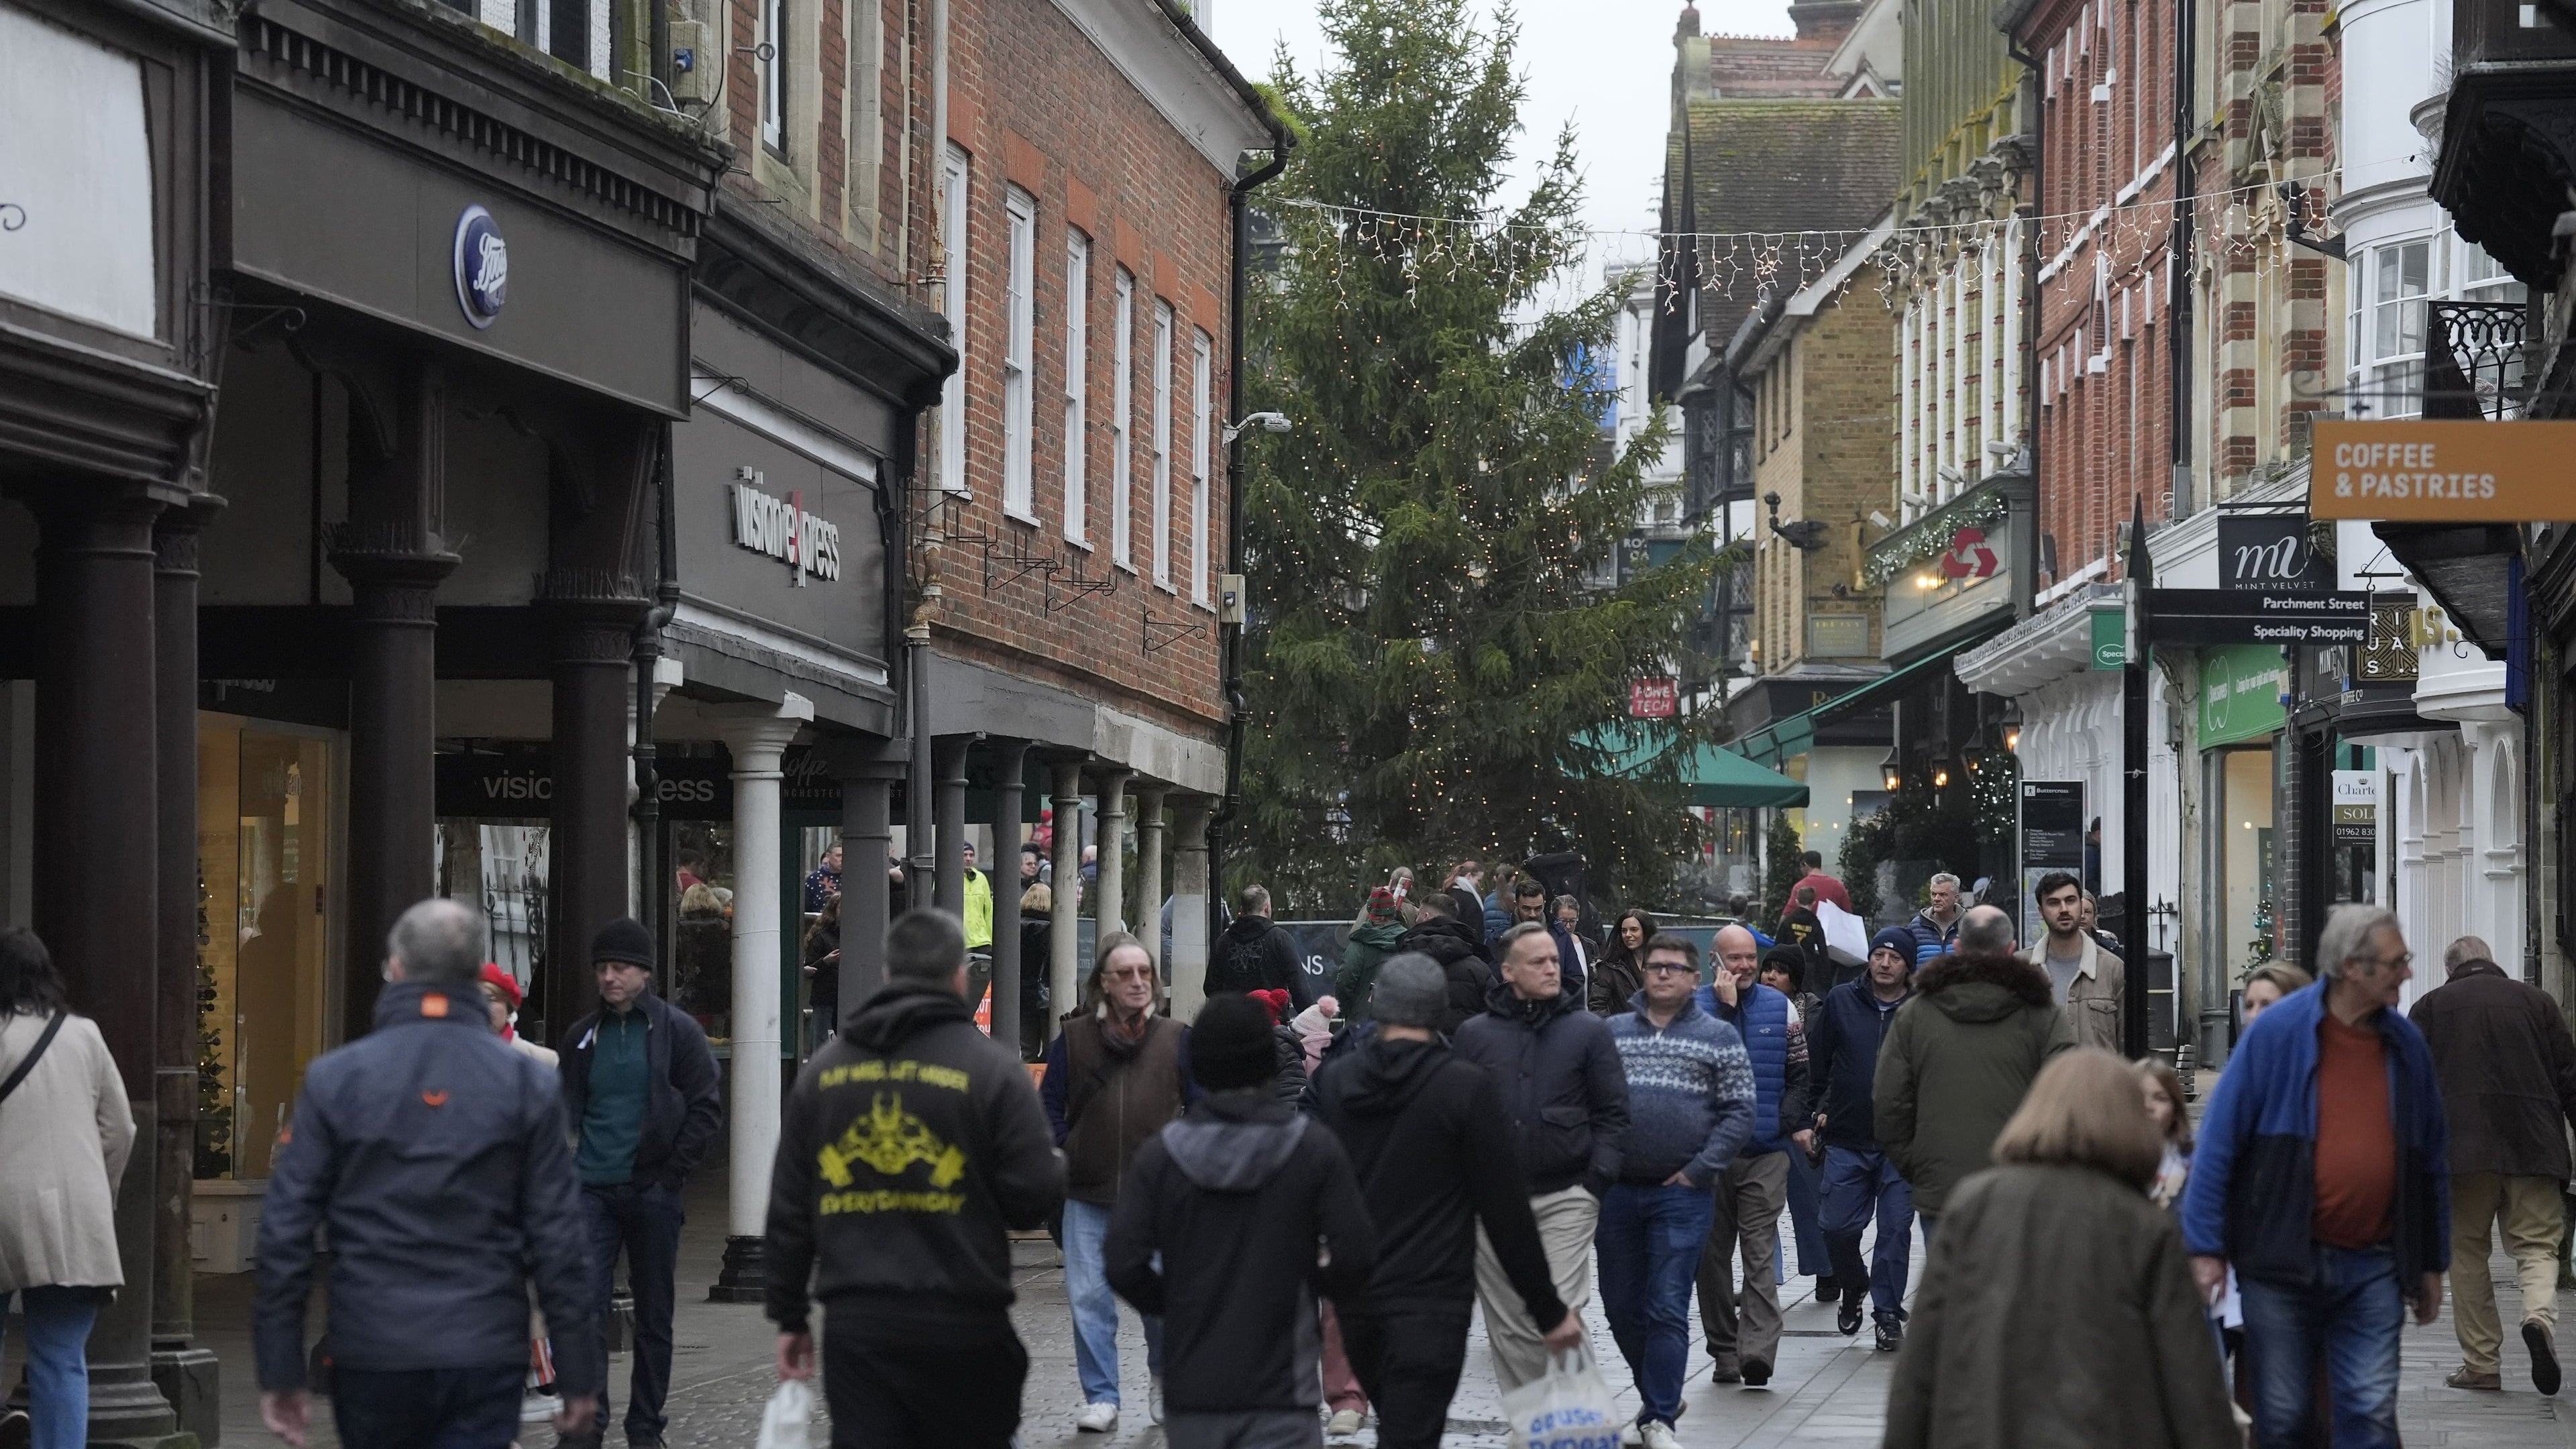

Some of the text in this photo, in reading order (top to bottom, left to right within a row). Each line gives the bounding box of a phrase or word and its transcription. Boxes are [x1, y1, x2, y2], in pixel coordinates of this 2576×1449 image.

[2334, 443, 2434, 468] COFFEE
[2334, 472, 2496, 498] & PASTRIES
[2271, 582, 2315, 590] VELVET
[2263, 597, 2365, 610] Parchment Street
[2253, 625, 2364, 641] Speciality Shopping
[2319, 647, 2334, 675] MIN
[483, 770, 714, 802] visio ess
[784, 788, 842, 798] NCHESTER
[2343, 808, 2375, 820] SOL
[2336, 828, 2359, 836] 01962
